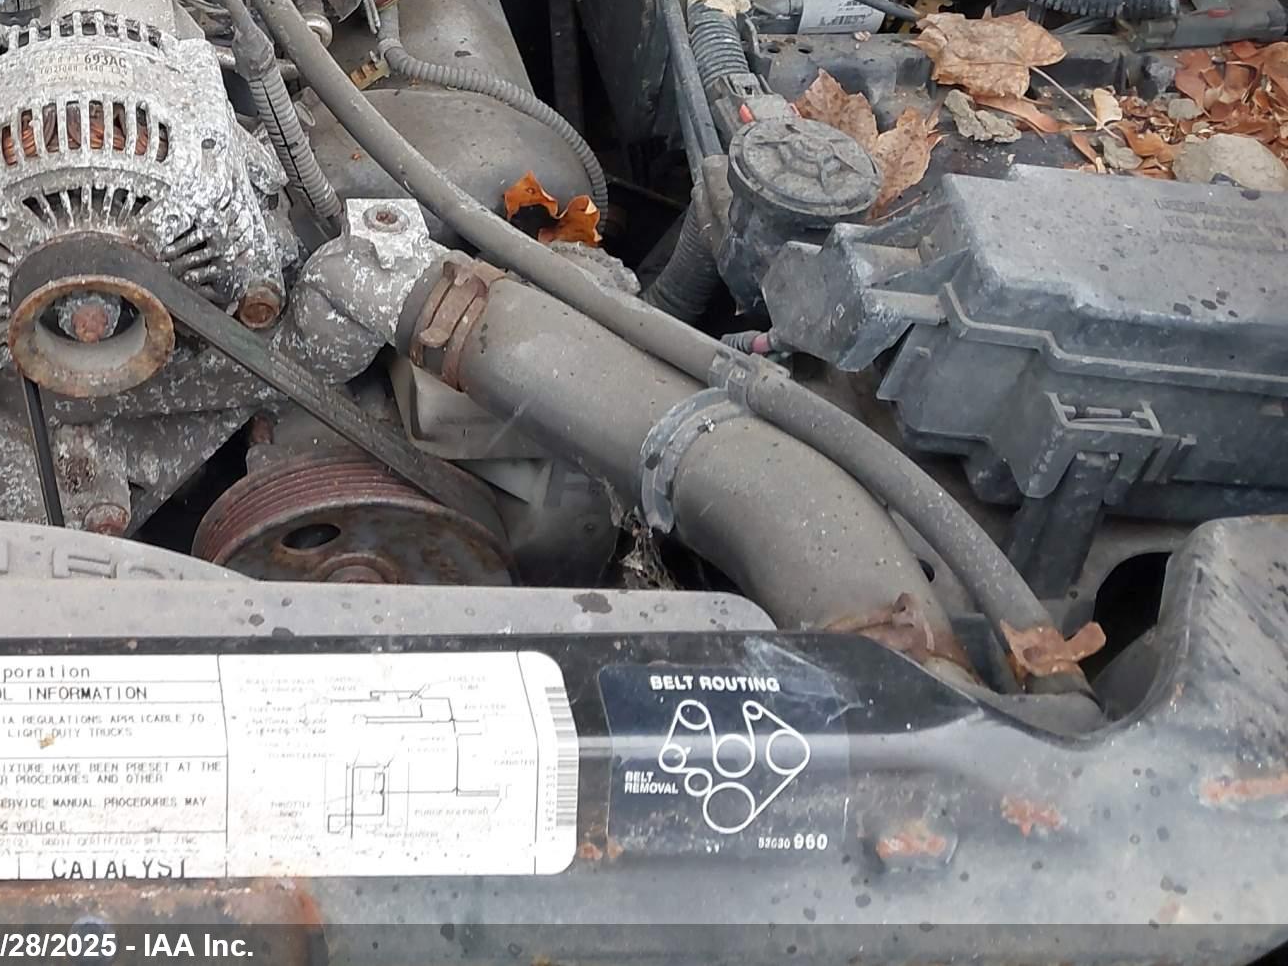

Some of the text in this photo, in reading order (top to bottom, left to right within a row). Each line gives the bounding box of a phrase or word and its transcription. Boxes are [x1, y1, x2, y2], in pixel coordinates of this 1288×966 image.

[84, 53, 127, 68] 693AC
[649, 675, 780, 692] BELT ROUTING
[28, 686, 148, 702] INFORMATION
[624, 770, 654, 782] BELT
[624, 782, 679, 794] REMOVAL
